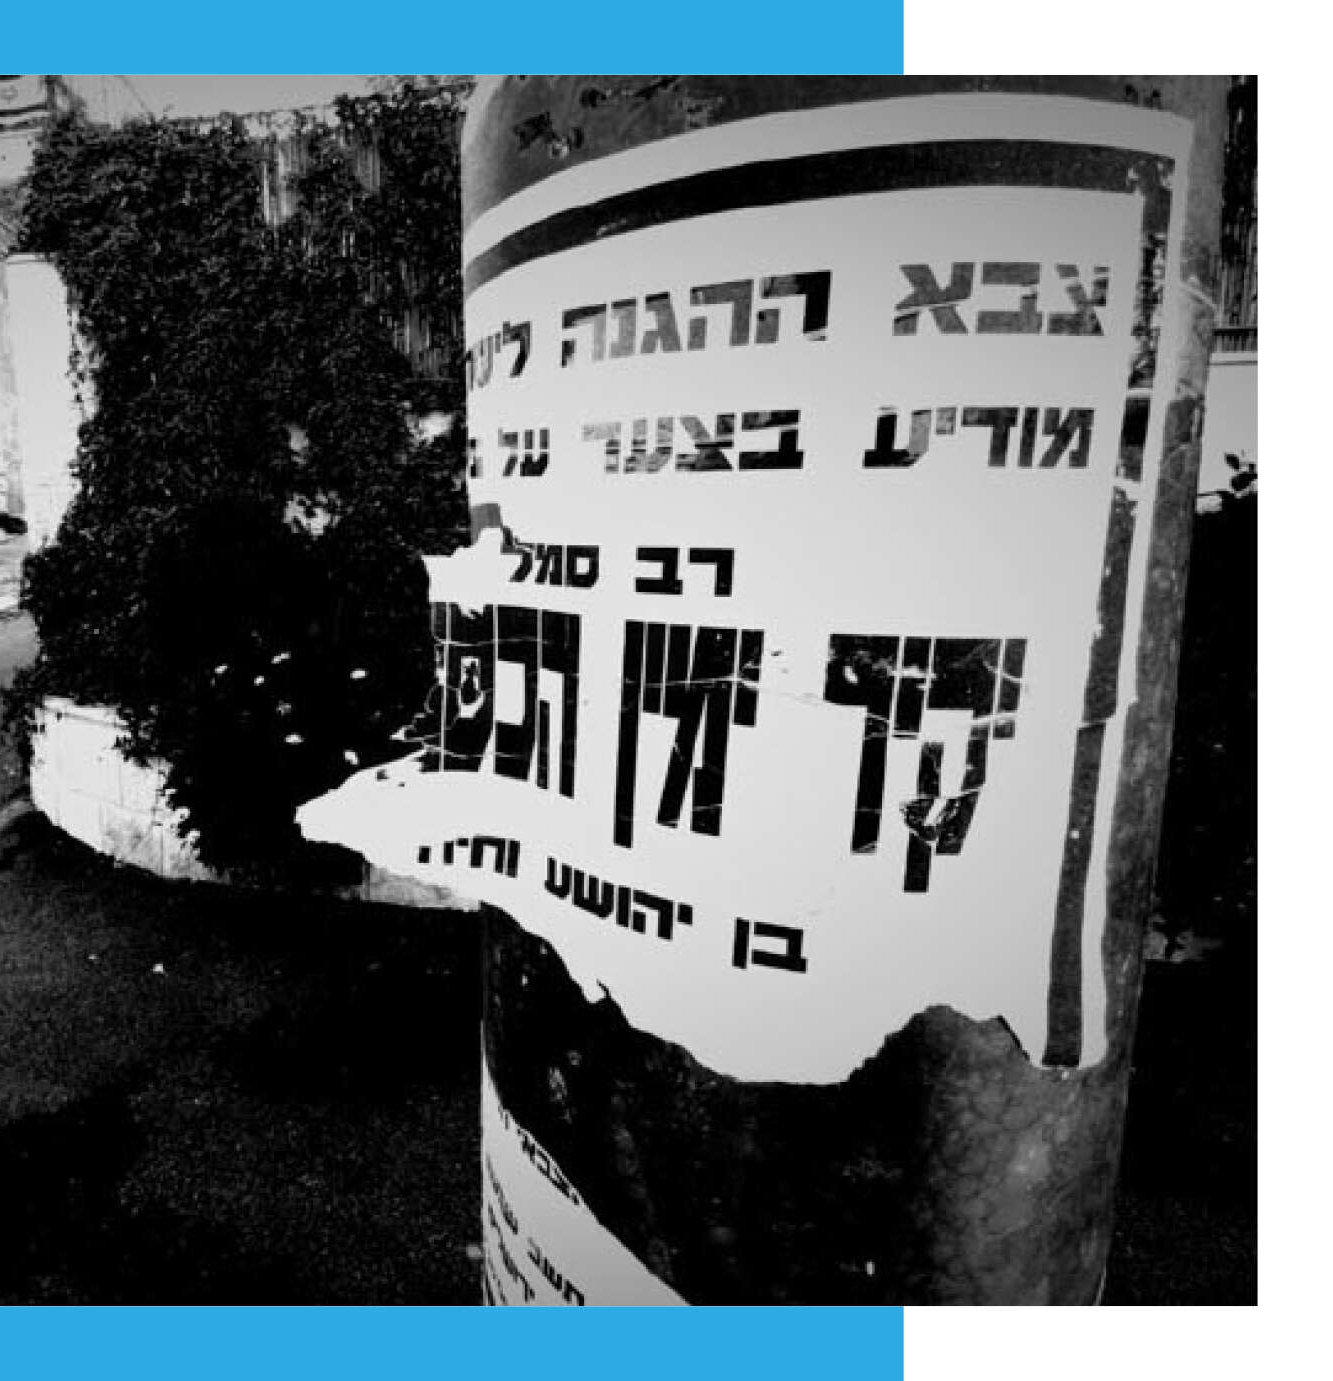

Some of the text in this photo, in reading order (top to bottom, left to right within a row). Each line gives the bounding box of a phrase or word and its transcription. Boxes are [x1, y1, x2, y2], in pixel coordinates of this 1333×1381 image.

[561, 269, 833, 368] ההגנה
[892, 261, 1110, 338] צבא
[498, 426, 550, 478] על
[581, 409, 805, 476] בצער
[862, 405, 1096, 469] מודיע
[504, 543, 734, 597] רב סמל
[612, 618, 766, 849] ימין
[823, 633, 1029, 894] יקיר
[544, 855, 694, 941] יהושע
[732, 917, 808, 974] בן
